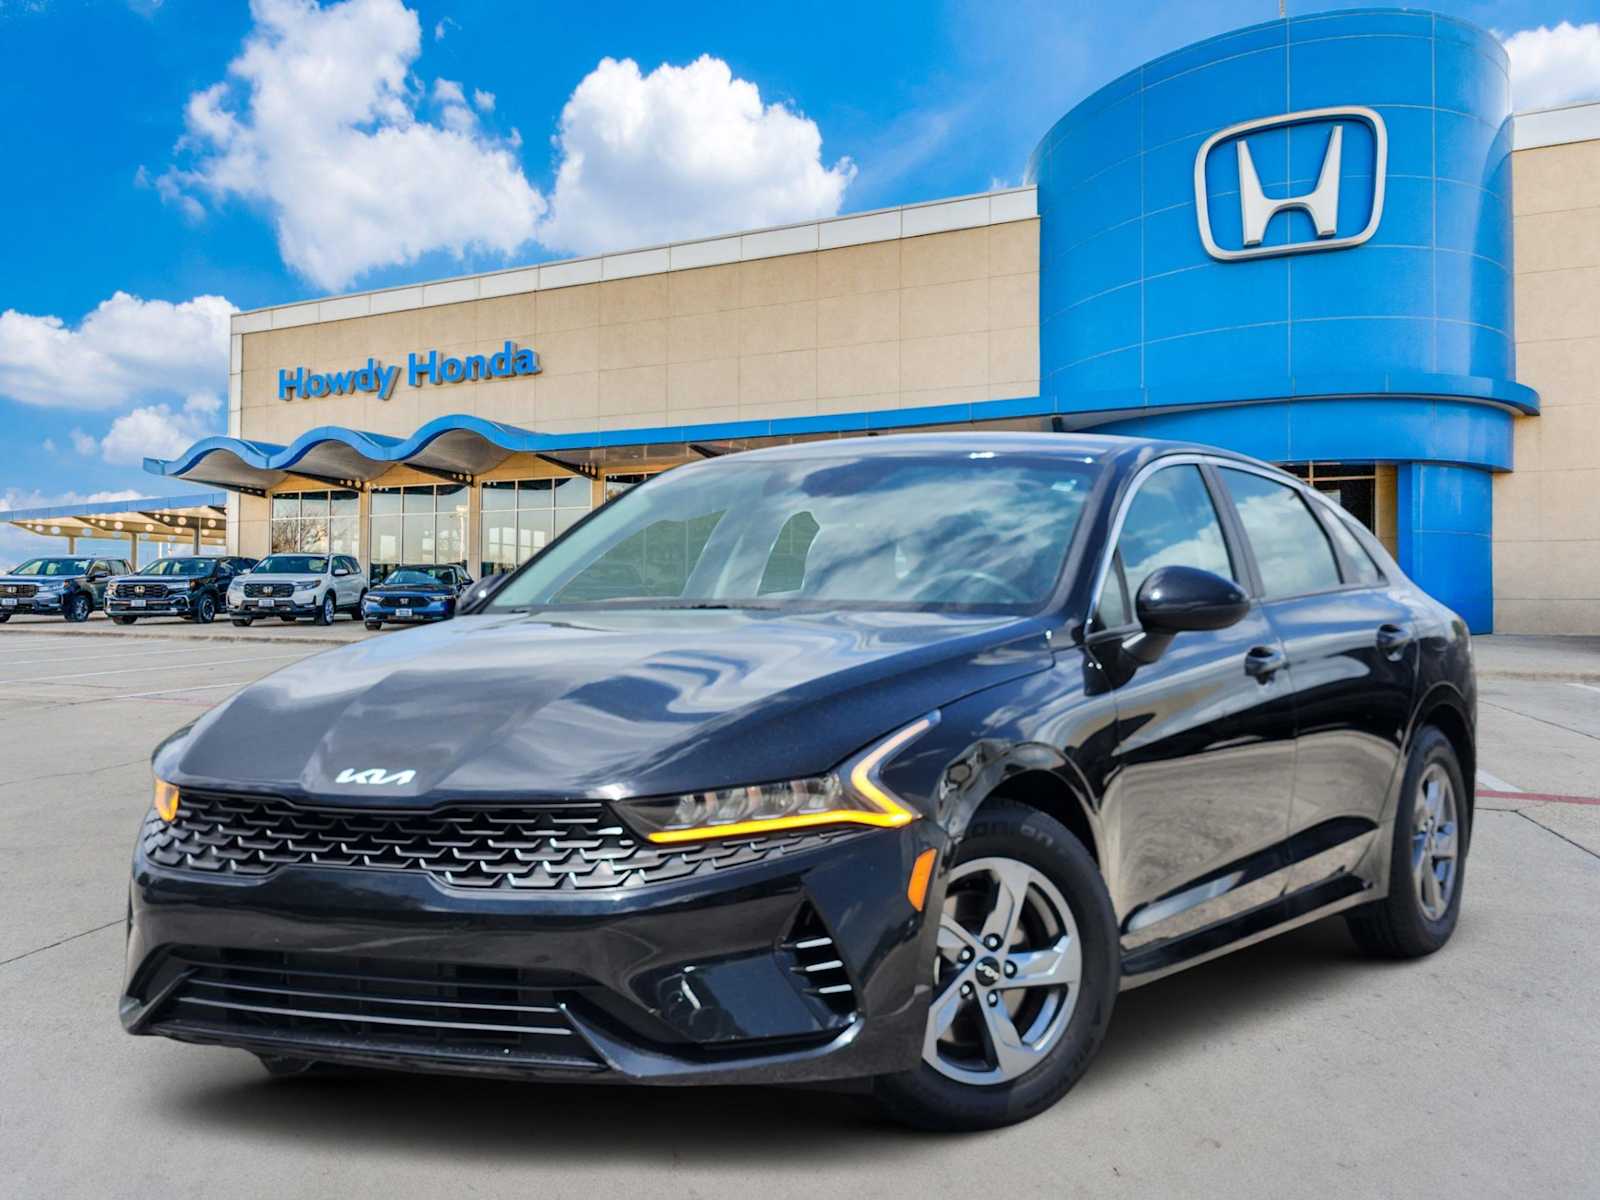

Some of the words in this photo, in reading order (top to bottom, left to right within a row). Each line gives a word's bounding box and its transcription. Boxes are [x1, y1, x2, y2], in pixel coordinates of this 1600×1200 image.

[278, 358, 400, 401] Howdy
[407, 341, 541, 388] Honda
[335, 768, 416, 786] KIA
